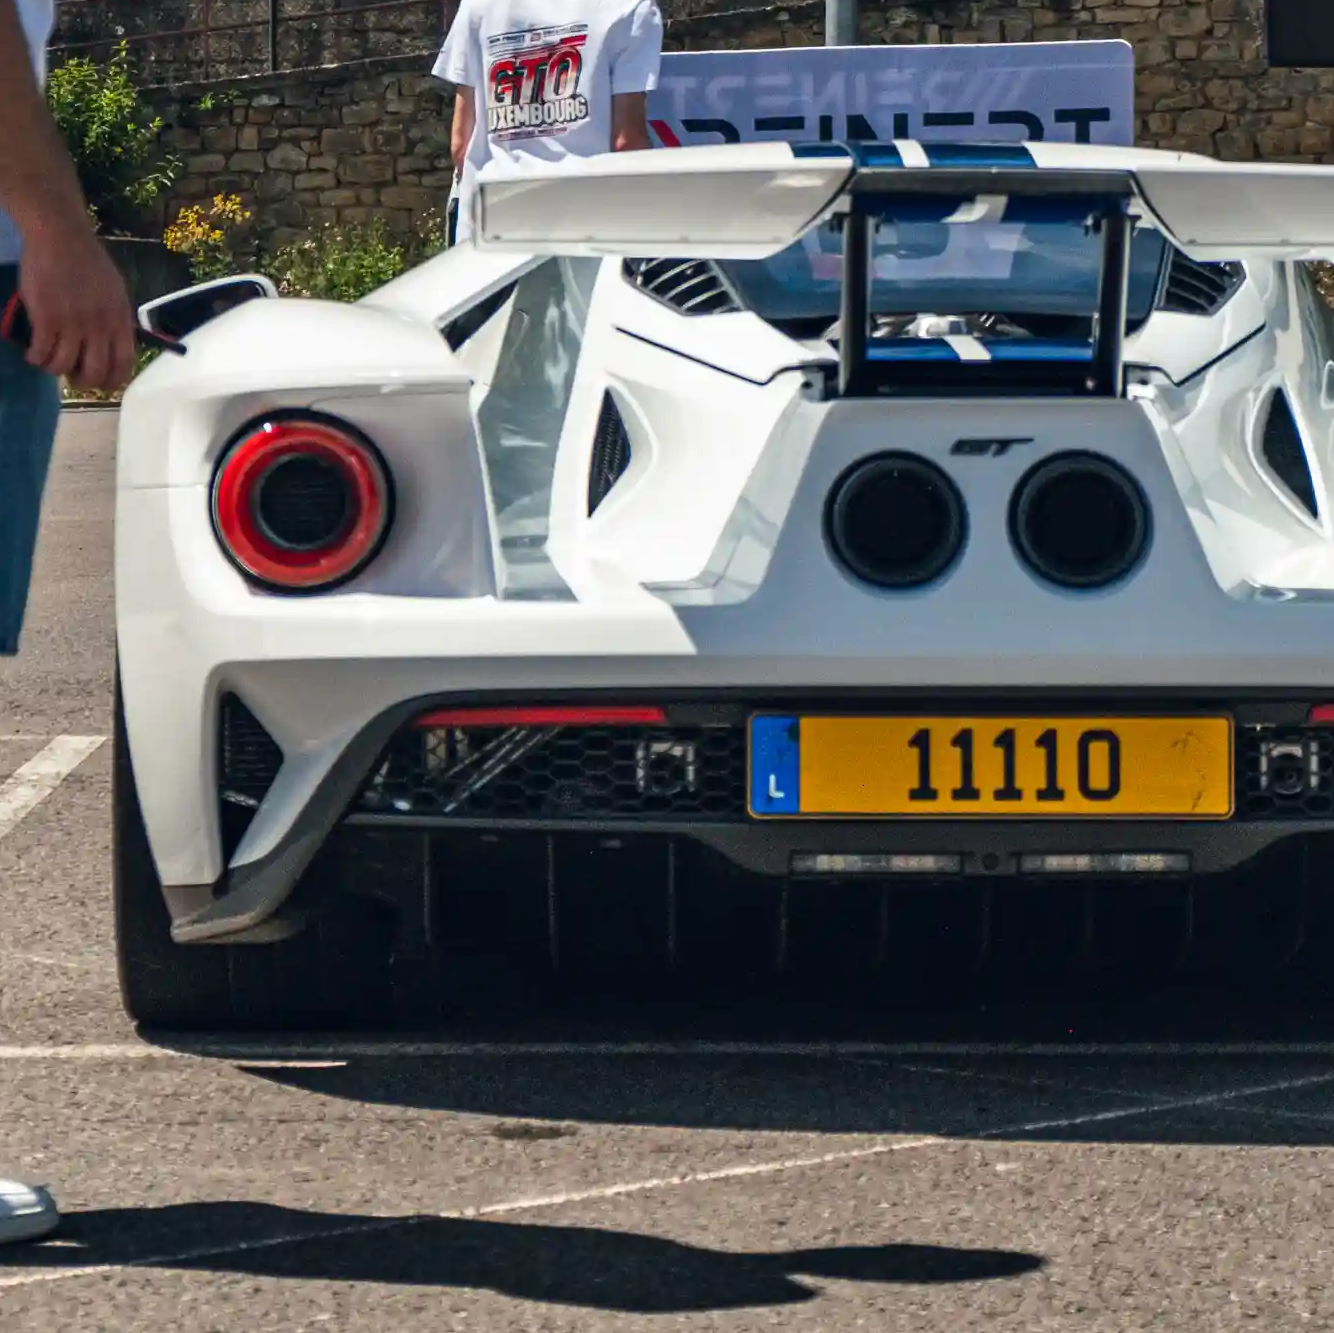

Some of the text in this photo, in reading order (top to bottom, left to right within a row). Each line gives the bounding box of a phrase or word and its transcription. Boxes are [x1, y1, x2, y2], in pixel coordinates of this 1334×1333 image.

[488, 46, 583, 107] GTO
[768, 727, 1121, 802] L 11110
